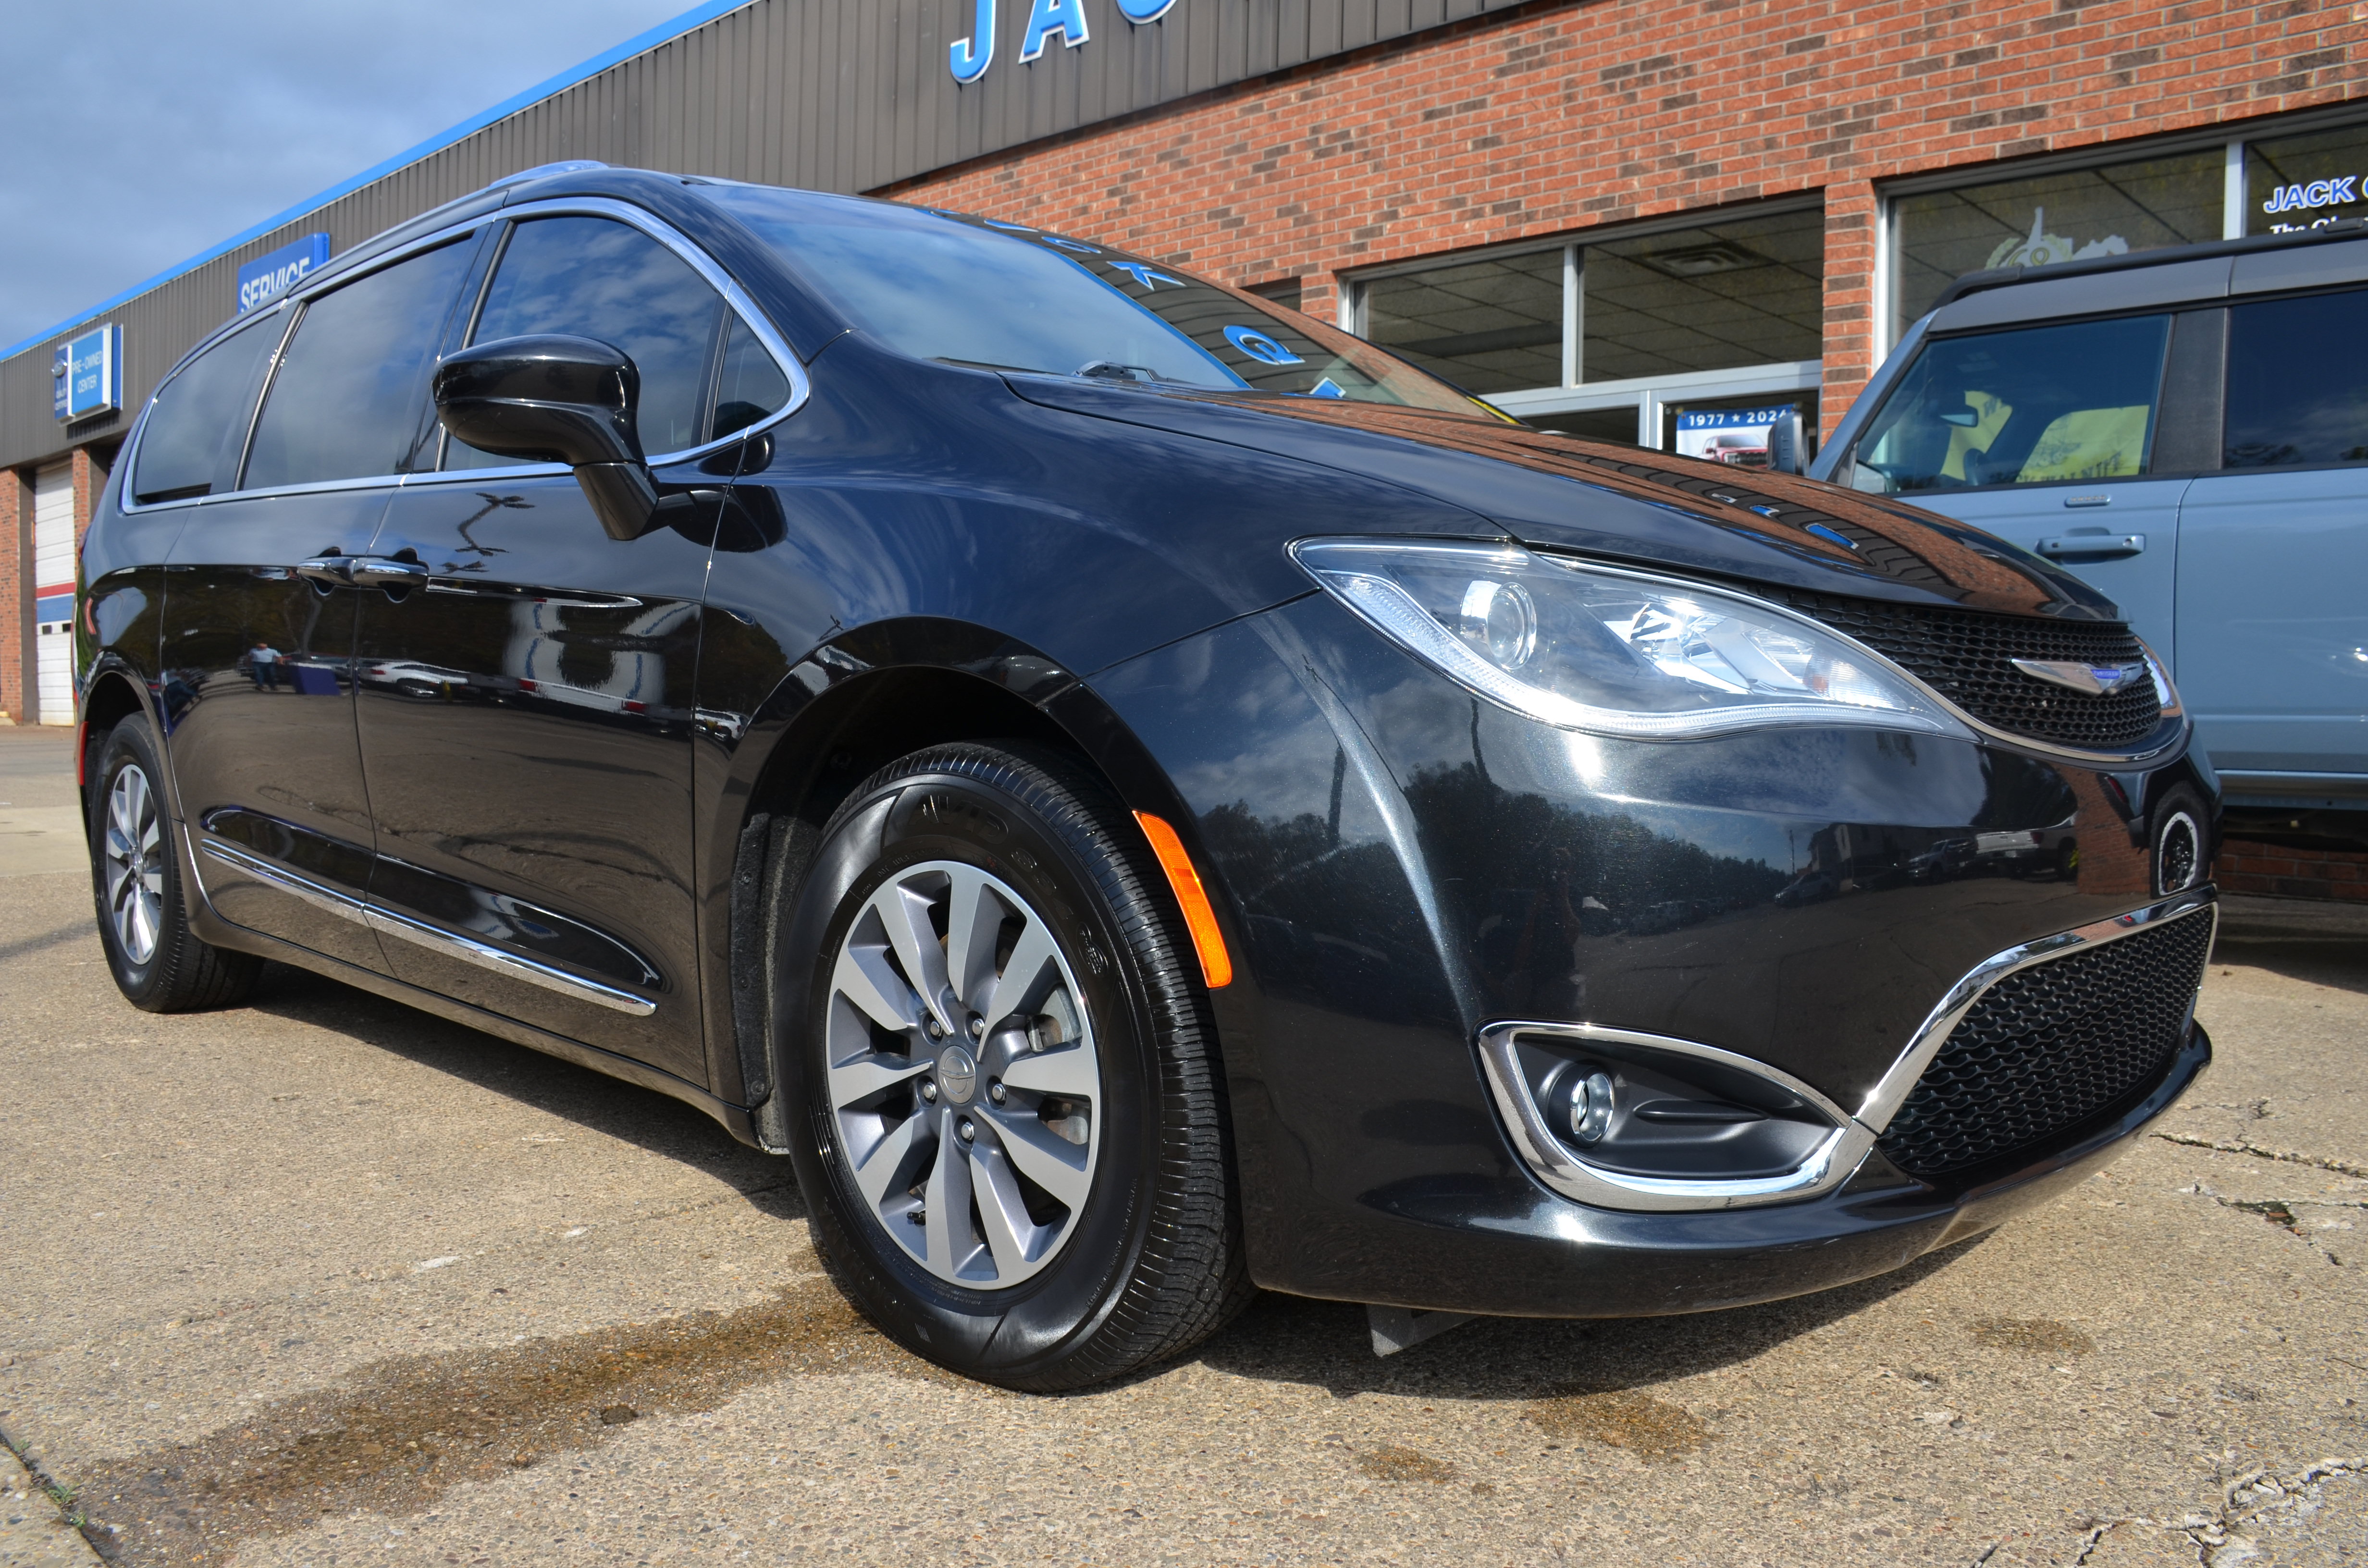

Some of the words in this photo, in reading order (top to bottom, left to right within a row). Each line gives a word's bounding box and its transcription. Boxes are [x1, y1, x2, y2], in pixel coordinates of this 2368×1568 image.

[950, 0, 1178, 84] JA
[2263, 175, 2357, 214] JACK
[77, 374, 98, 393] CENTER
[1689, 414, 1725, 427] 1977
